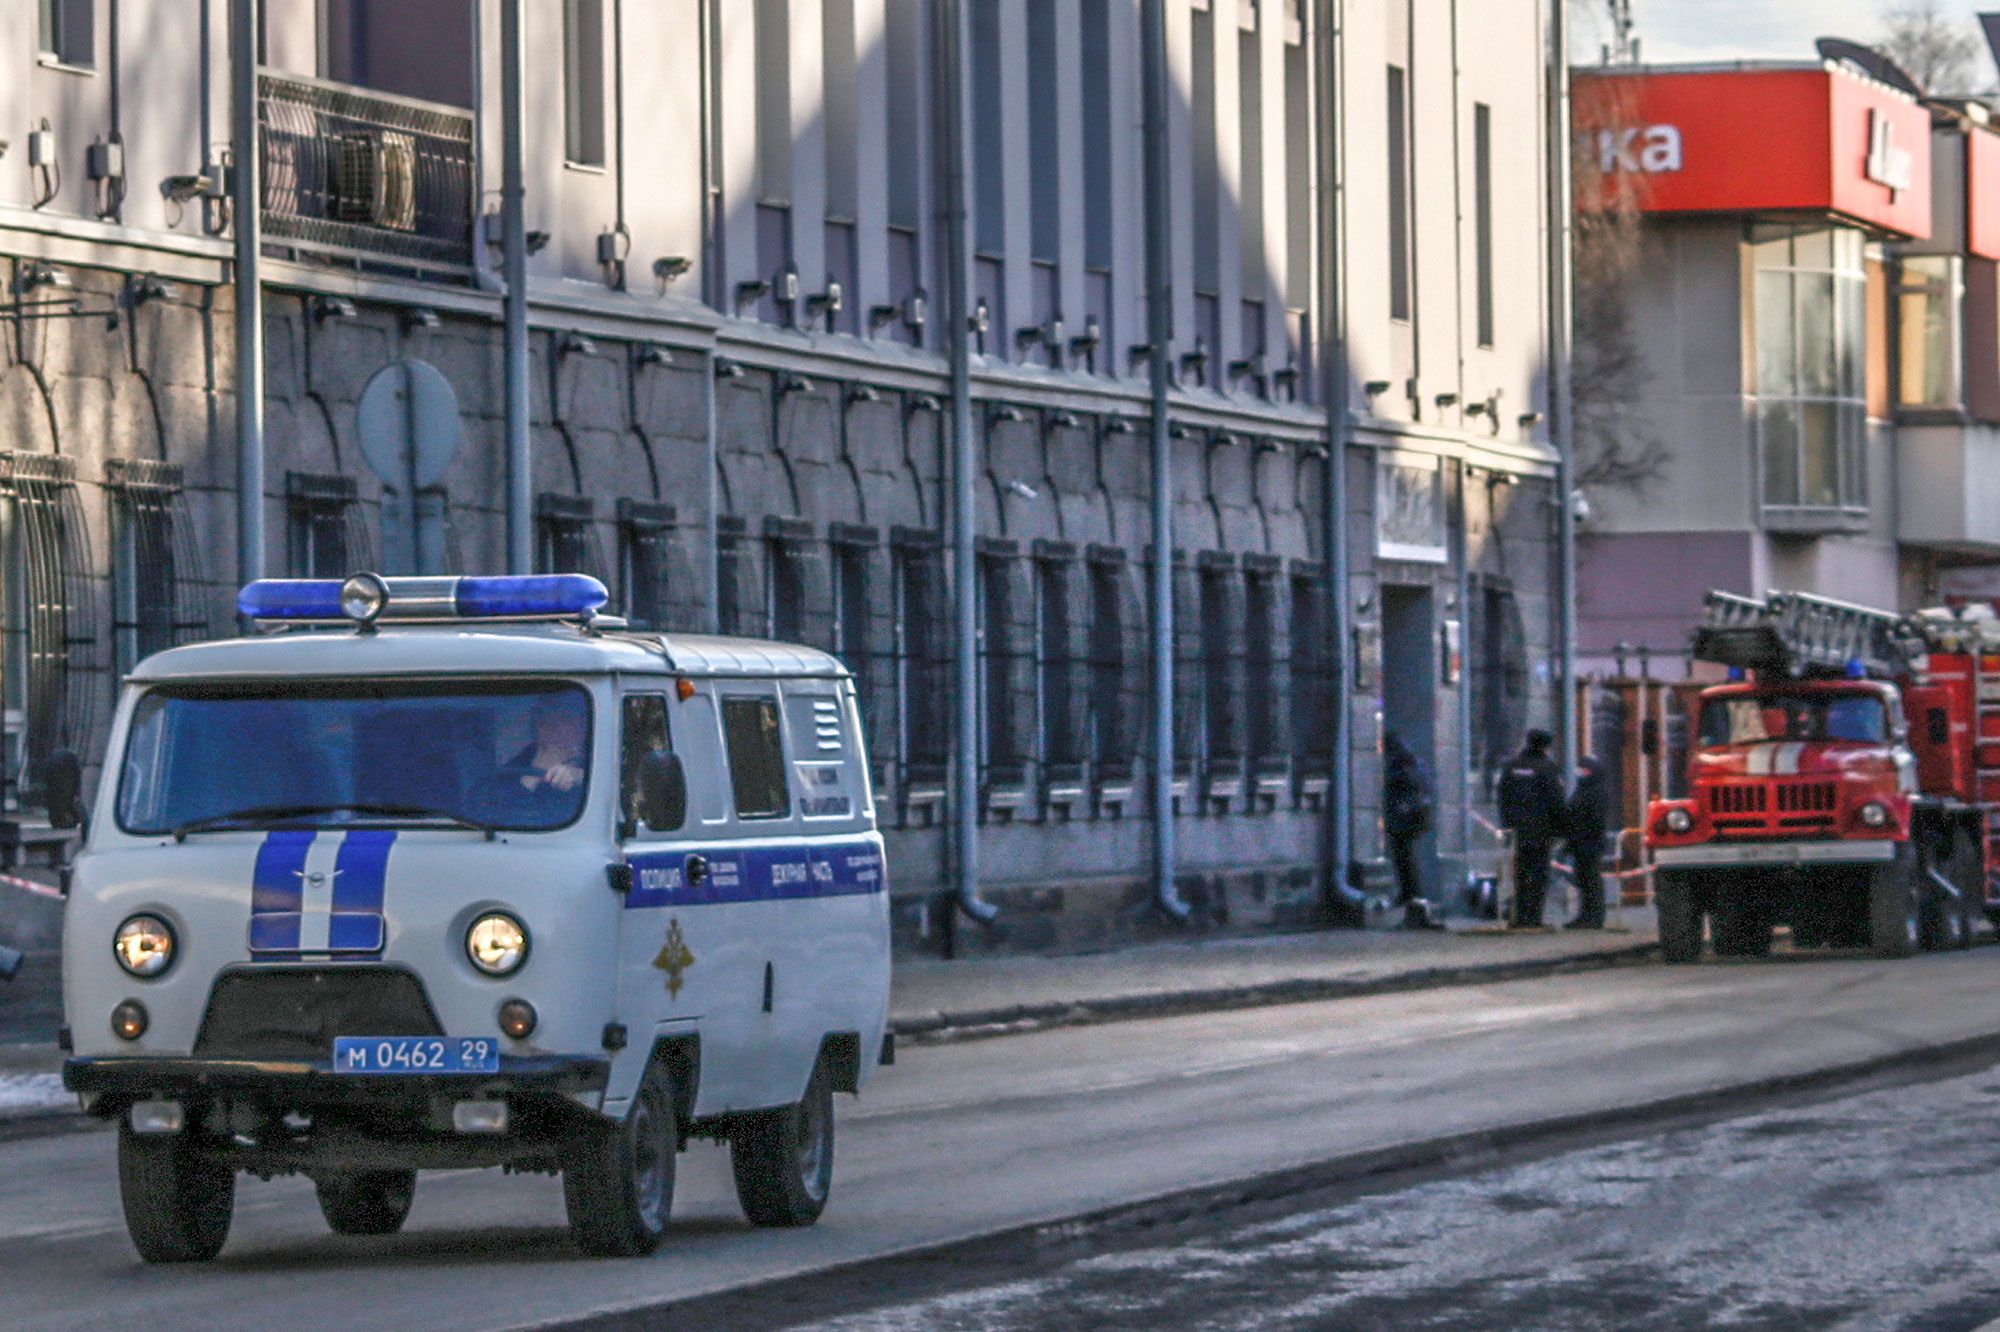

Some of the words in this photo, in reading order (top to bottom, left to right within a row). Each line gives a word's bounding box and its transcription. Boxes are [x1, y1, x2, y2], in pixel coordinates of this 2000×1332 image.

[1577, 124, 1685, 173] ка
[376, 1041, 446, 1068] 0462
[461, 1040, 489, 1061] 29
